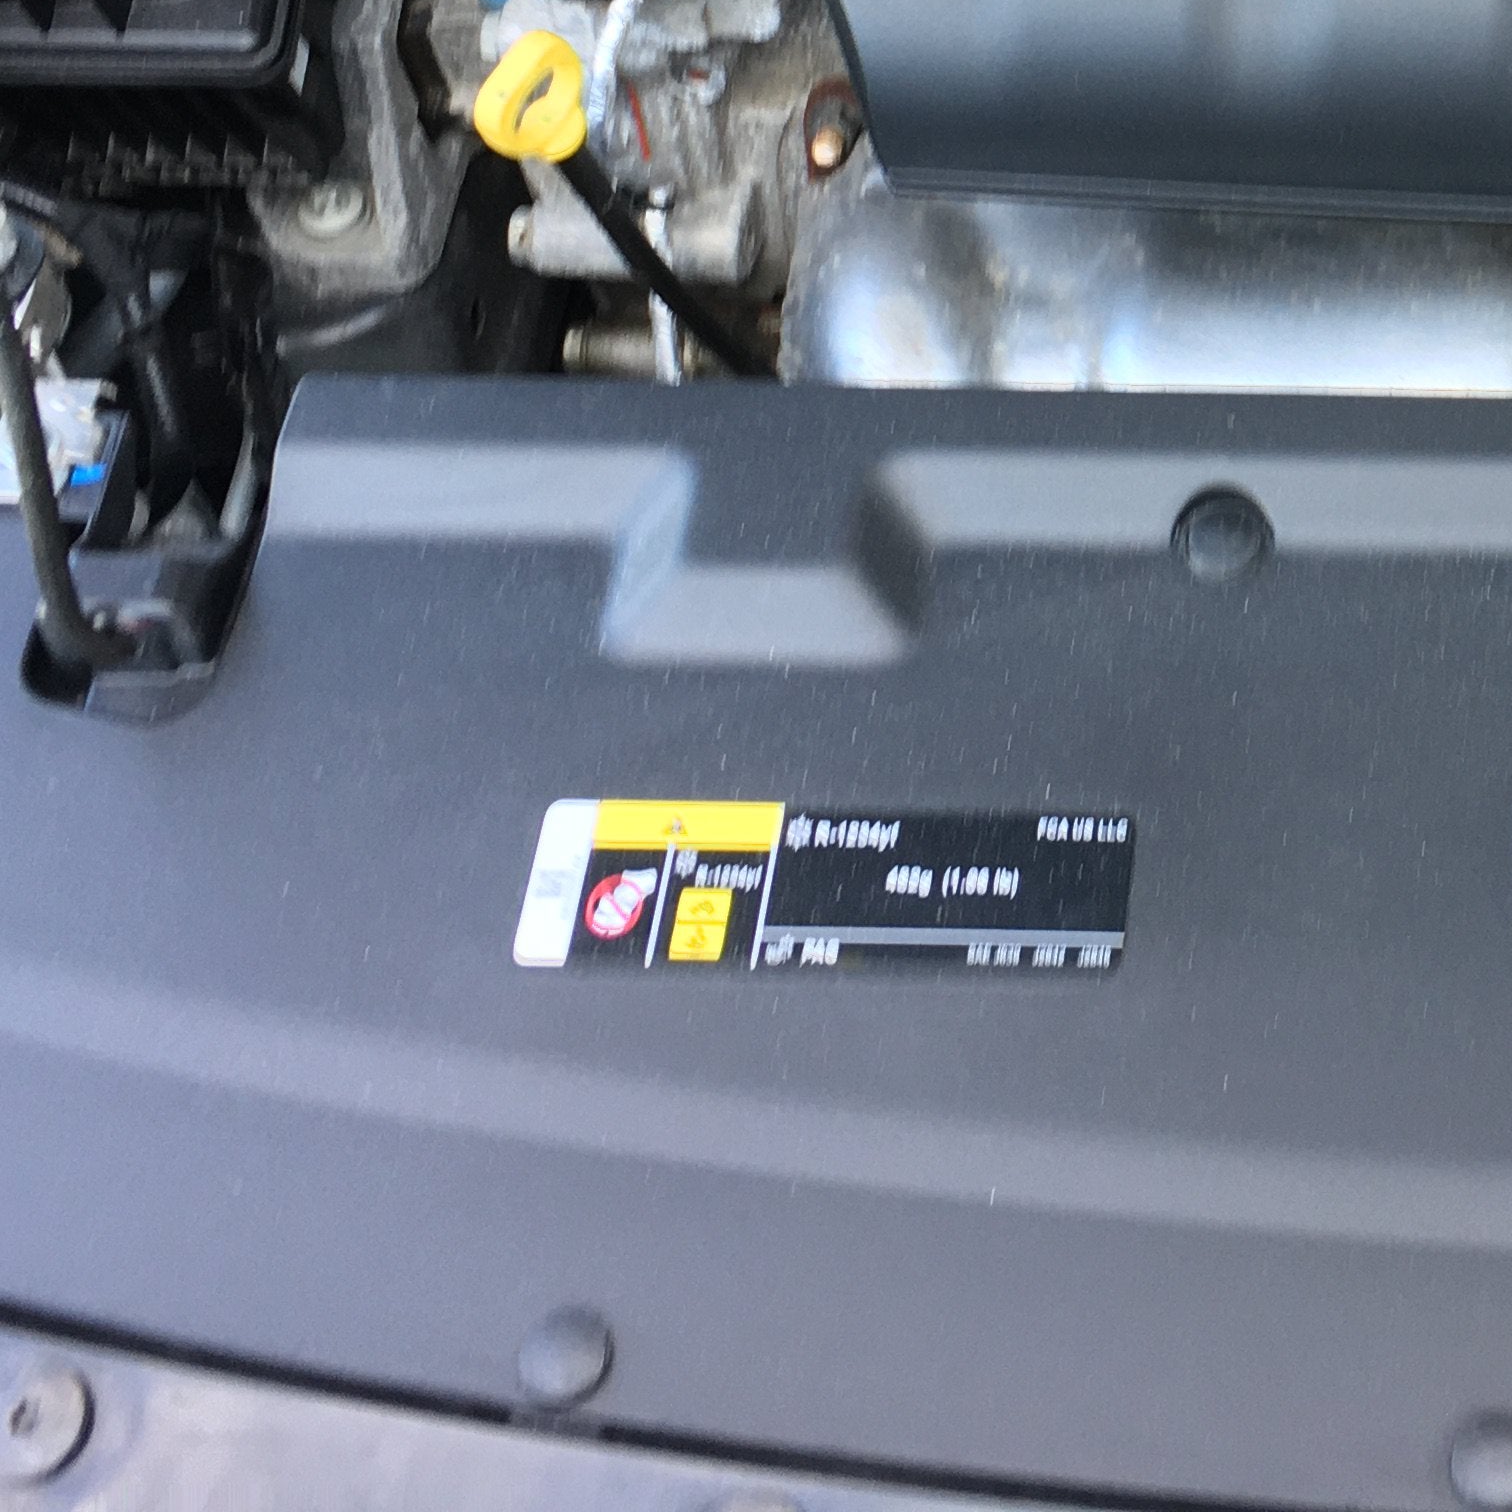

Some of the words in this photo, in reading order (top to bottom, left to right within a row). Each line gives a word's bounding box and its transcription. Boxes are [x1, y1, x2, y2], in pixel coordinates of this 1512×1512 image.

[1036, 815, 1069, 842] FCA
[1072, 816, 1094, 842] US
[1097, 817, 1128, 843] LLC
